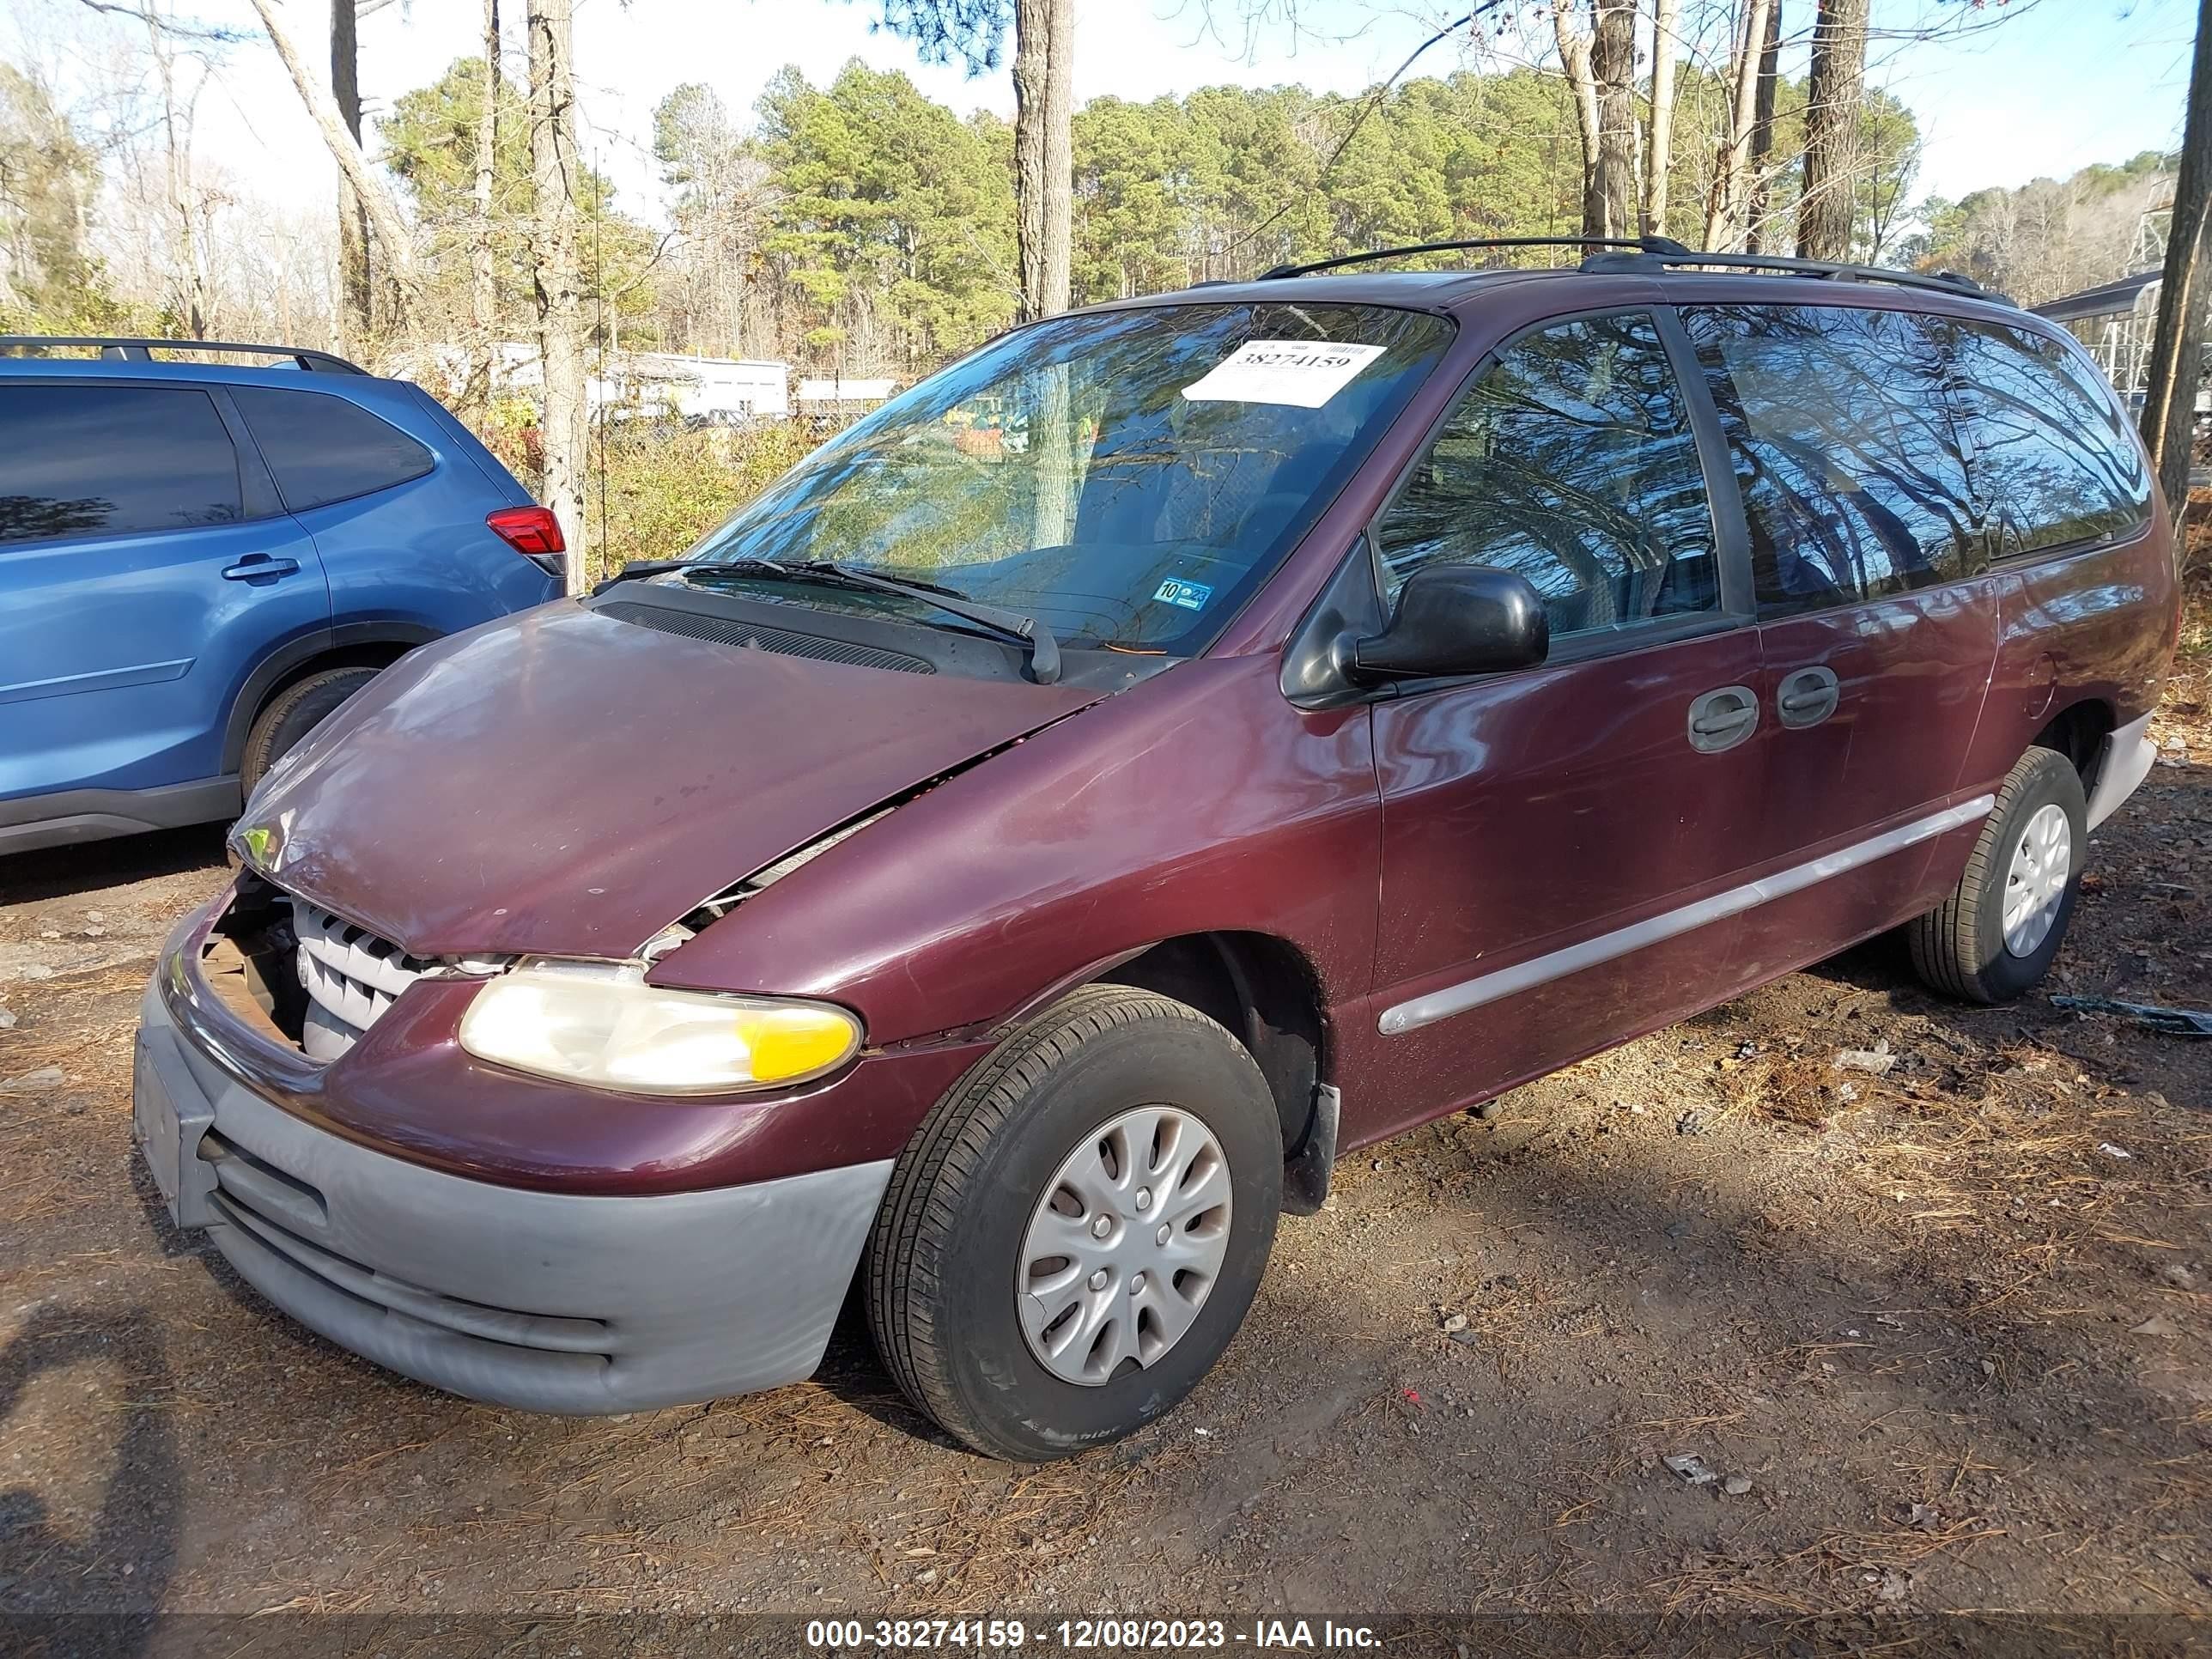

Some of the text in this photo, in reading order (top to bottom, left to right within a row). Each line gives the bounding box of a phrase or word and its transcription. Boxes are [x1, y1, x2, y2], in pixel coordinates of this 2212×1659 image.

[1237, 353, 1351, 368] 38274159
[1161, 583, 1207, 602] 10 23
